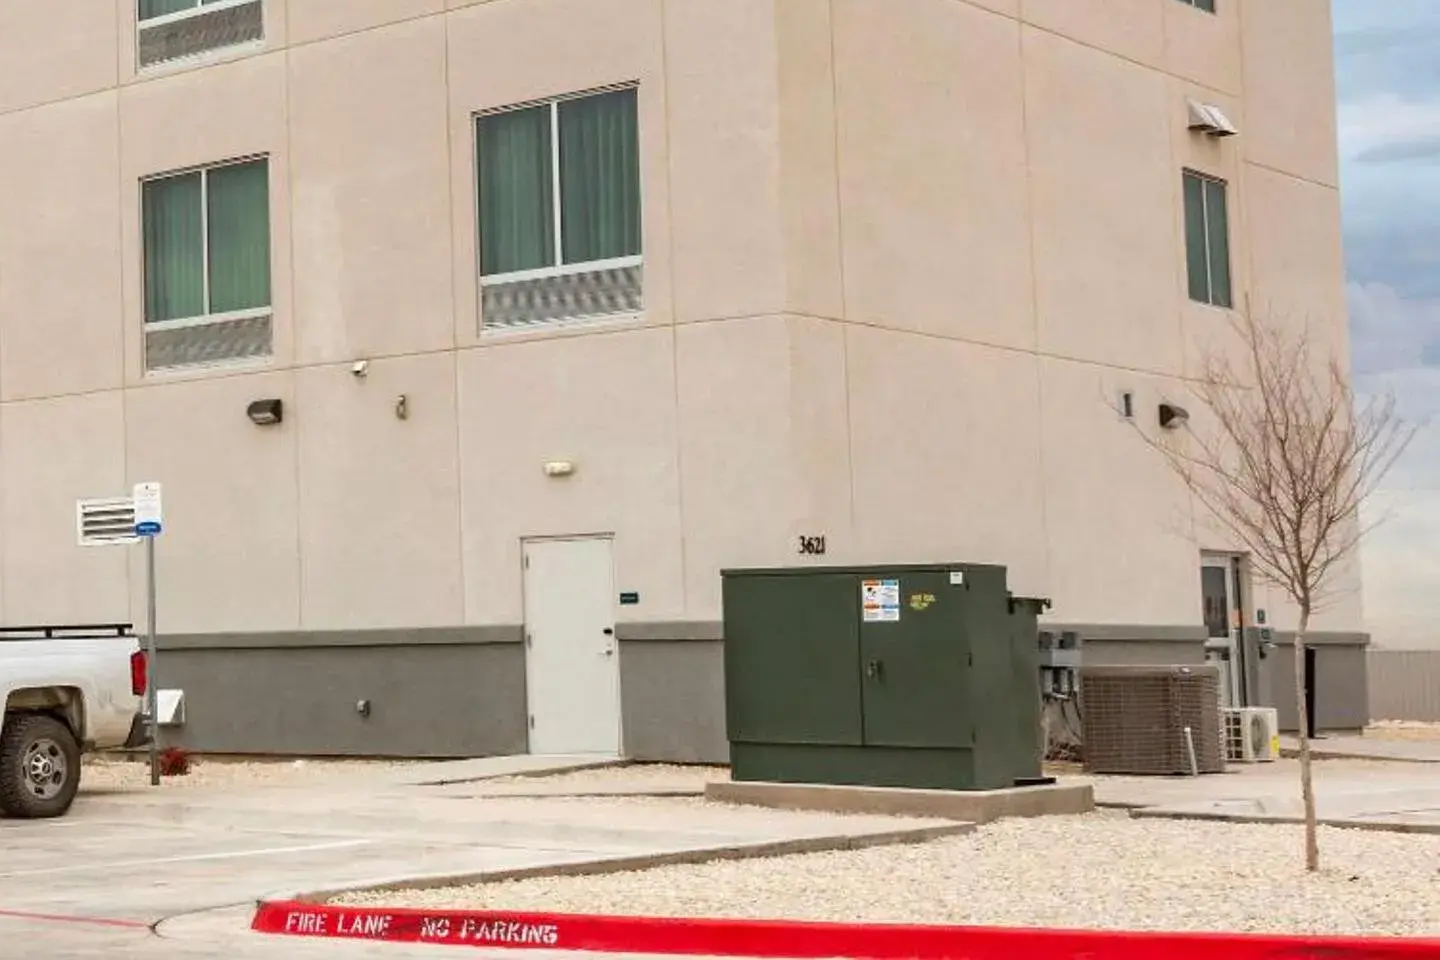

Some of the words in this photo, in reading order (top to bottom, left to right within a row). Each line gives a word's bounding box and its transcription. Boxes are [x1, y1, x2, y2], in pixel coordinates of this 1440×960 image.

[798, 535, 826, 554] 3621
[285, 912, 327, 934] FIRE
[337, 913, 393, 936] LANE
[420, 916, 451, 938] NO
[460, 918, 559, 944] PARKING
